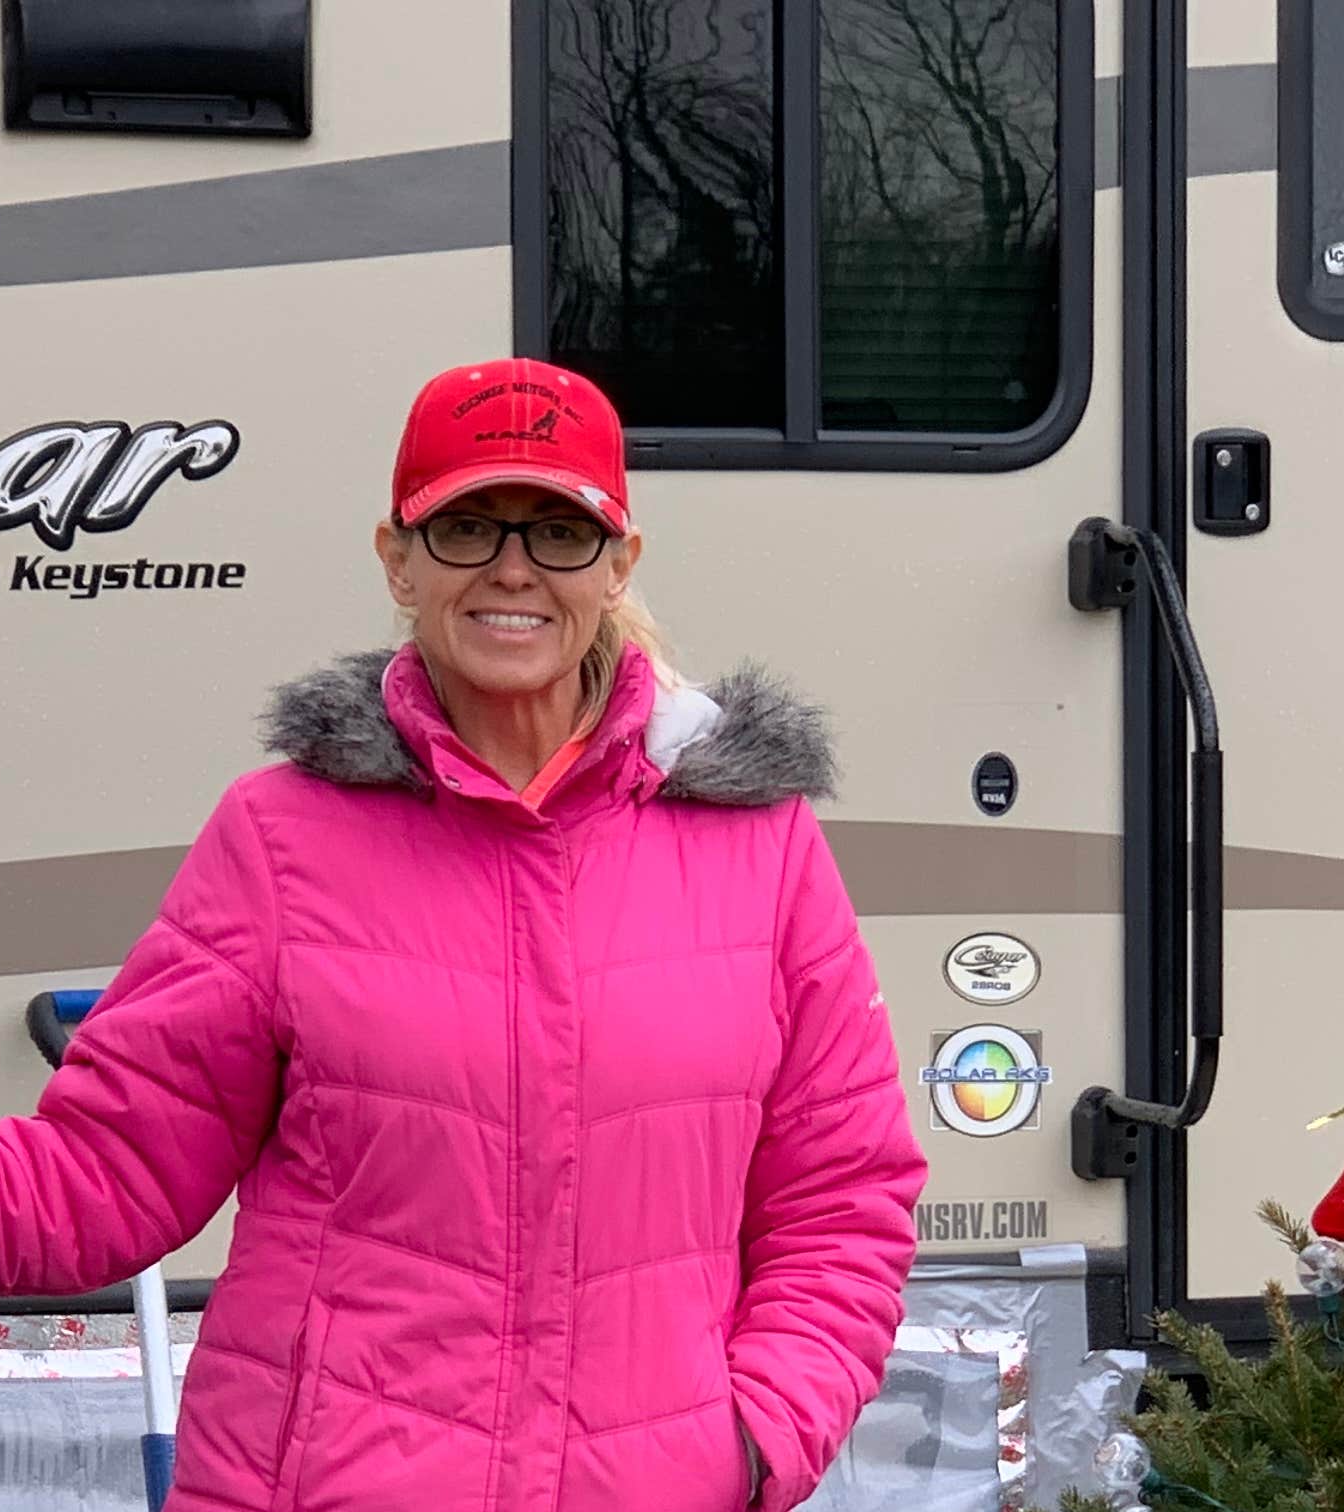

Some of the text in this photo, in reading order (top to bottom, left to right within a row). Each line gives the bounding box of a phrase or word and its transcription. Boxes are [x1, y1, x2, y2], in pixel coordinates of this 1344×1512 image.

[475, 431, 559, 445] MACK
[12, 556, 247, 600] Keystone
[954, 944, 1028, 967] Cougar
[916, 1201, 1048, 1241] NSRV.COM
